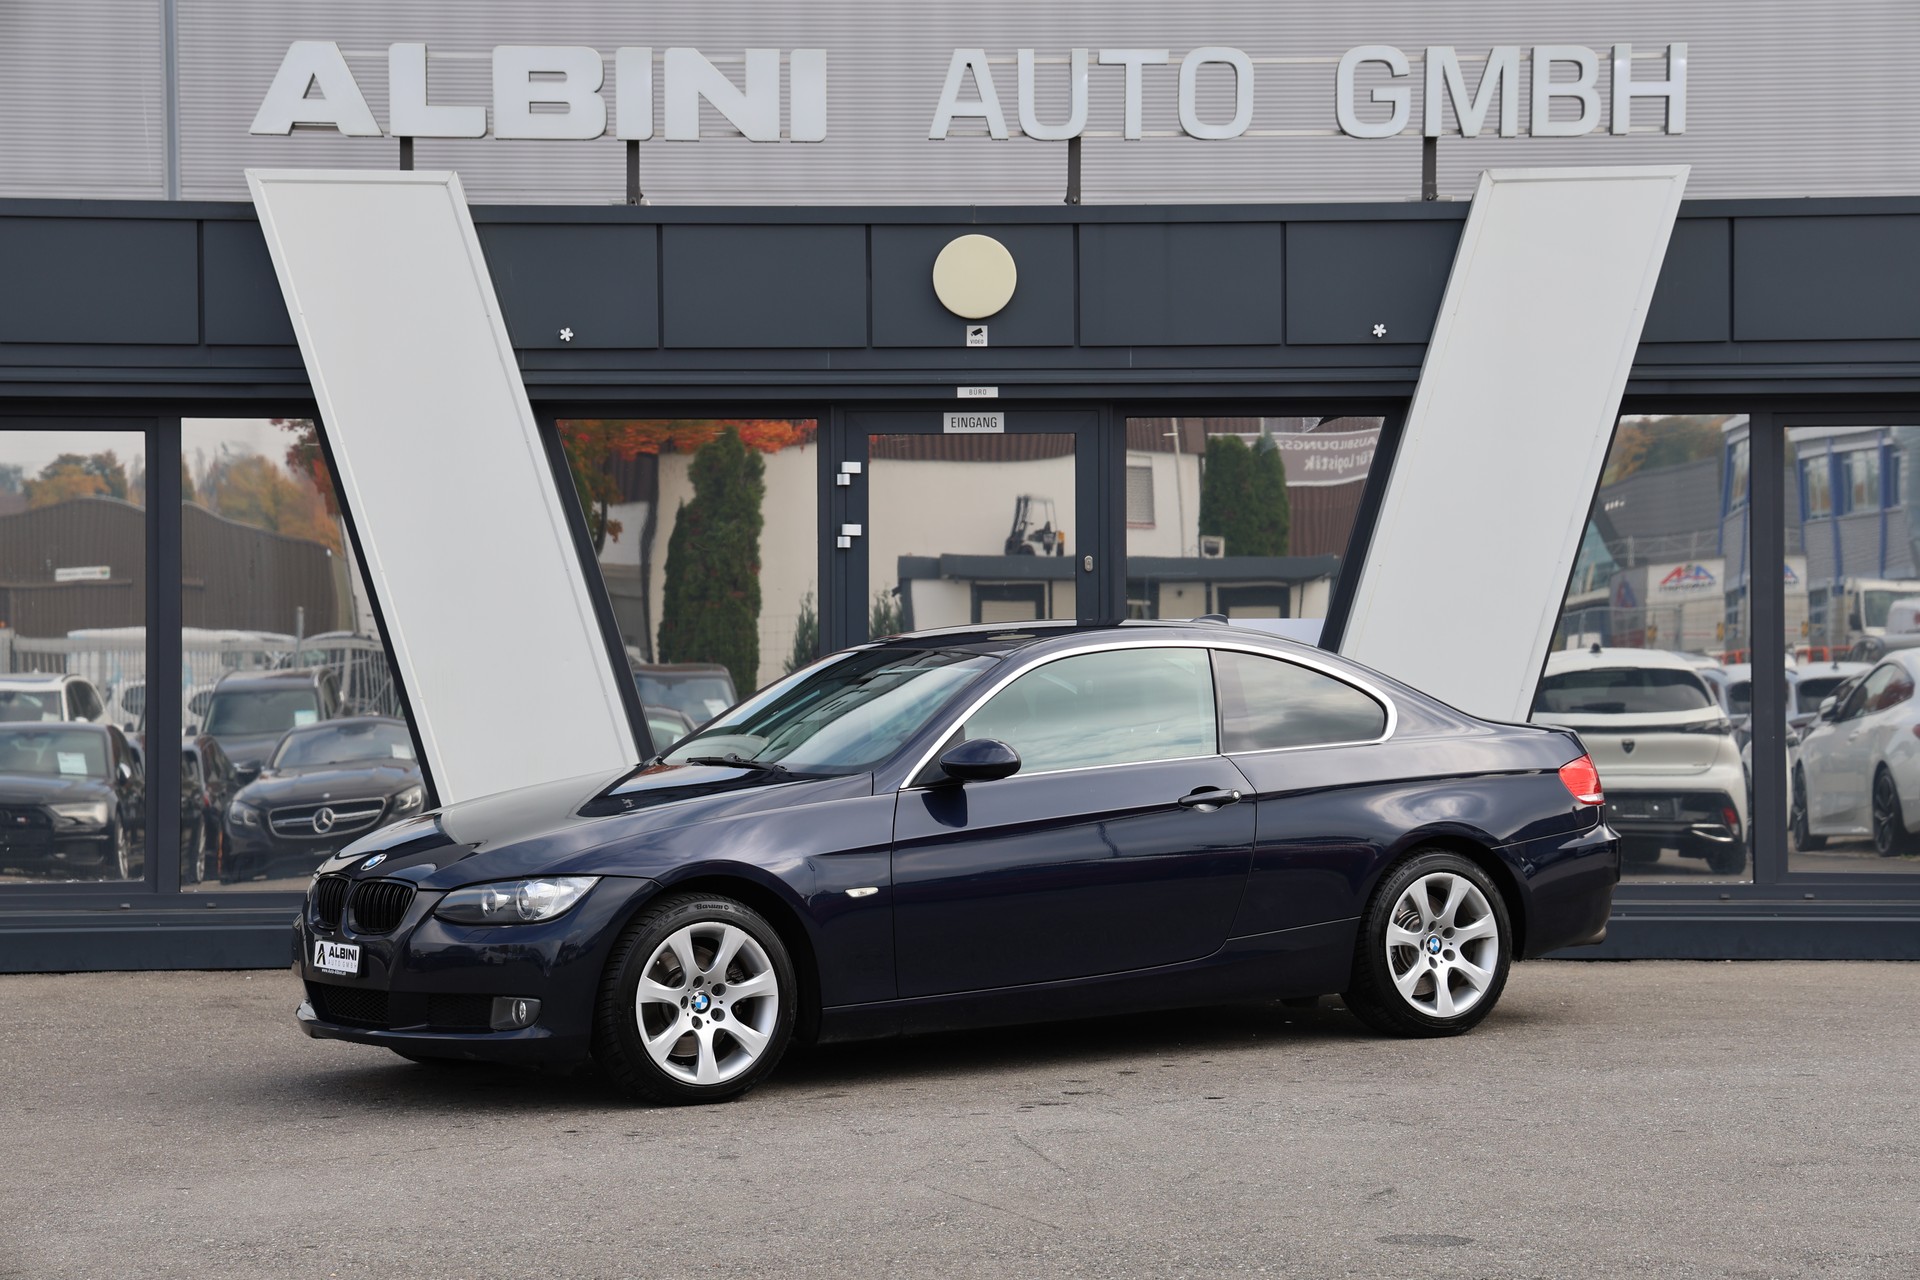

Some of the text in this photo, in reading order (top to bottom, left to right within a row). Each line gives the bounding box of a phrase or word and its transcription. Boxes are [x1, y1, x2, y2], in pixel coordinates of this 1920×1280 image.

[249, 40, 1687, 142] ALBINI AUTO GMBH
[951, 417, 997, 428] EINGANG
[329, 946, 357, 960] ALBINI
